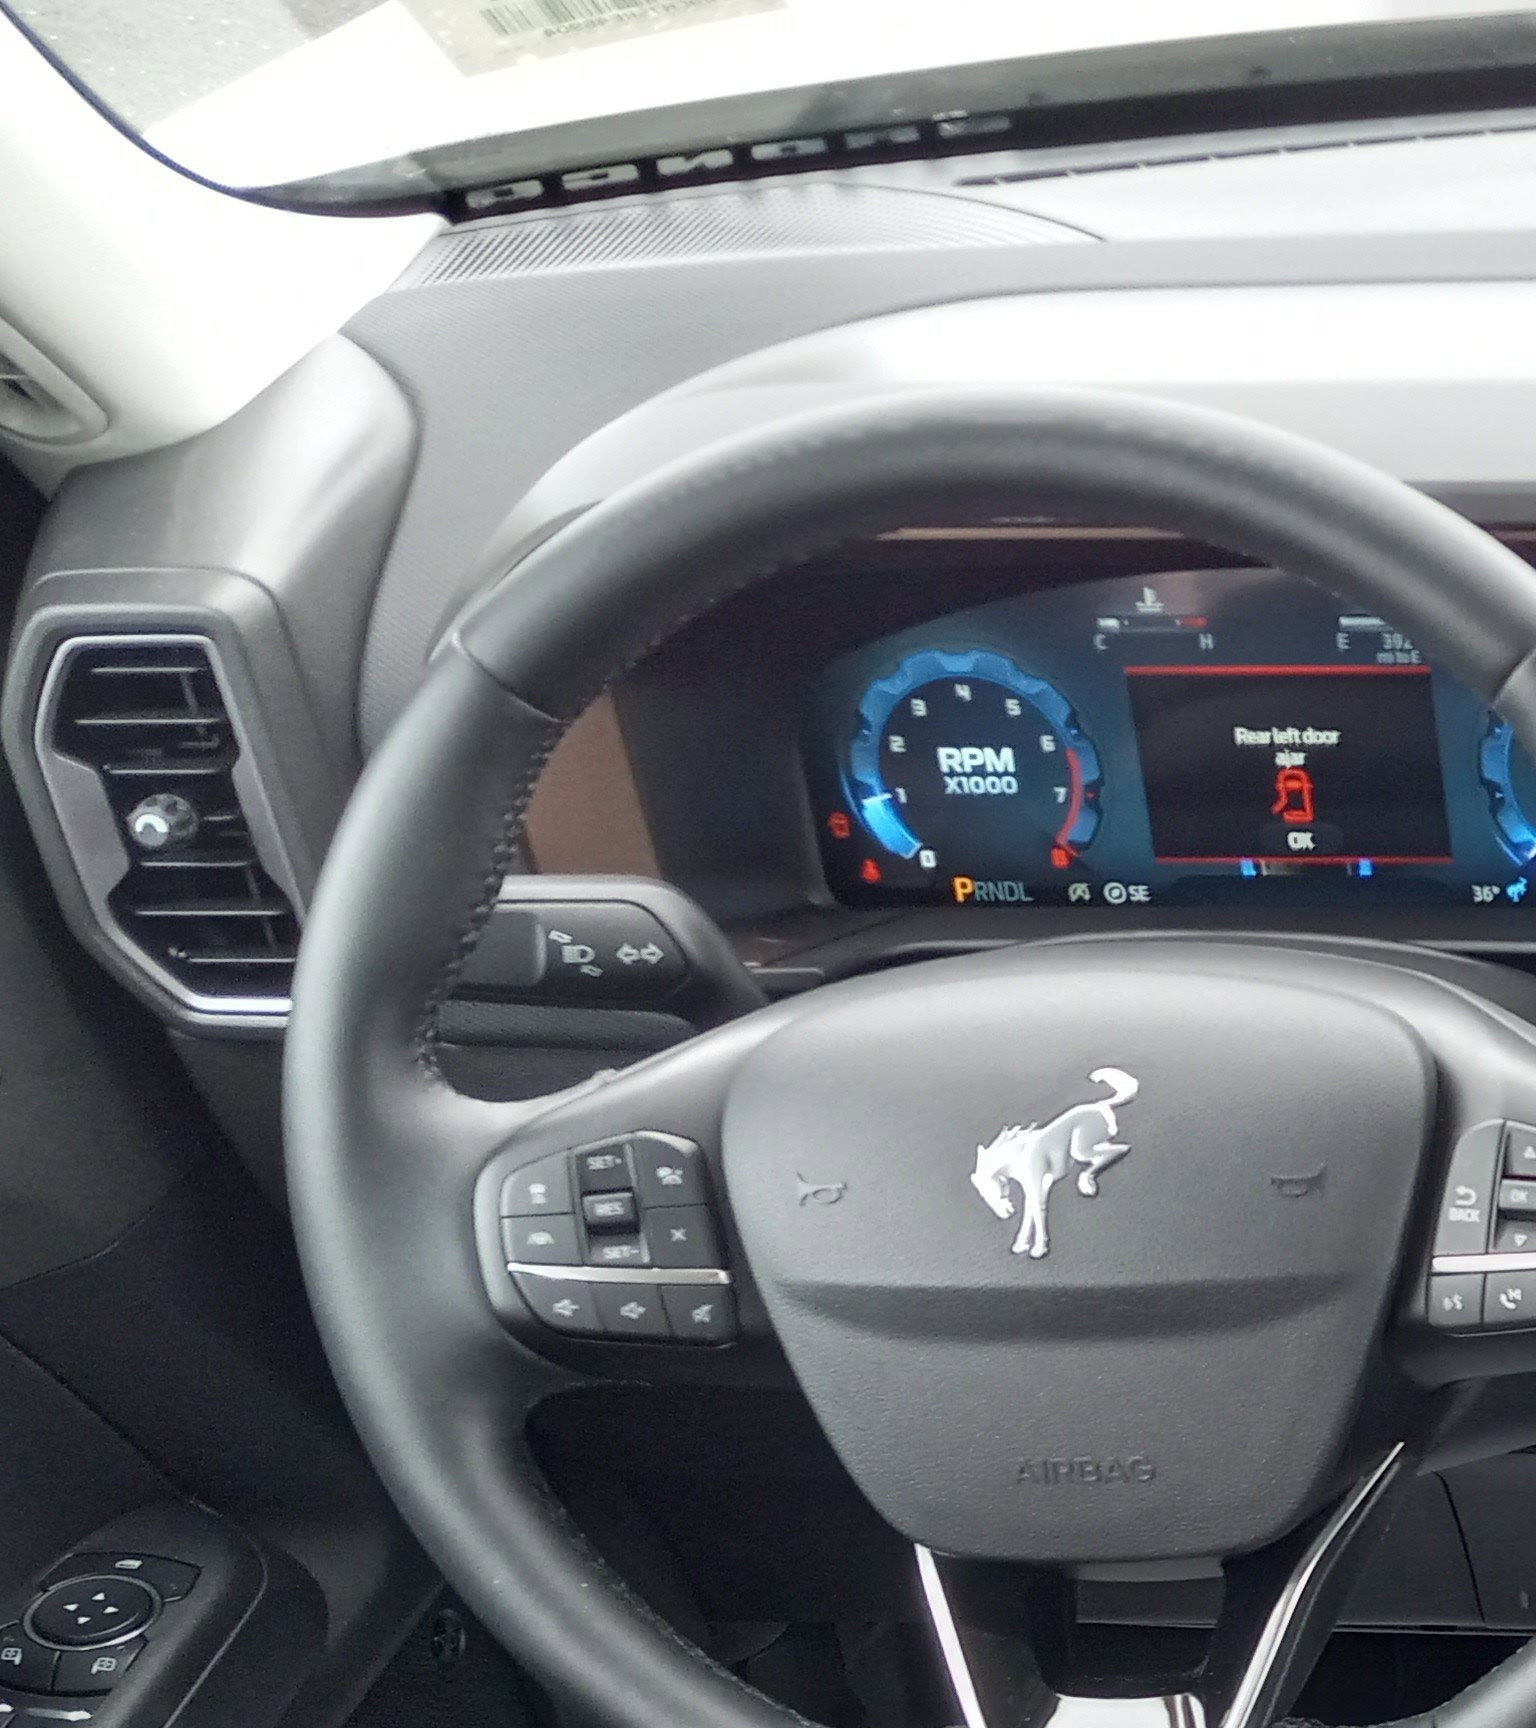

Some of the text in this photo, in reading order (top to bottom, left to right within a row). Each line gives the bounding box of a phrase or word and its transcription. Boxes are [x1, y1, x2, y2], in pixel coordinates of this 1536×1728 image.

[1093, 633, 1107, 650] C
[1199, 633, 1214, 649] H
[1336, 632, 1351, 650] E
[954, 684, 971, 701] 4
[910, 698, 928, 717] 3
[1004, 698, 1022, 716] 5
[889, 735, 907, 753] 2
[1039, 734, 1056, 753] 6
[1233, 726, 1341, 745] Rear left door
[937, 747, 1016, 773] RPM
[943, 776, 1019, 795] X1000
[1053, 786, 1068, 803] 7
[895, 787, 908, 804] 1
[1287, 831, 1316, 851] OK
[919, 849, 937, 868] 0
[1128, 885, 1150, 901] SE
[1510, 1189, 1529, 1203] OK
[1449, 1207, 1480, 1223] BACK
[1016, 1455, 1158, 1485] AIRBAG
